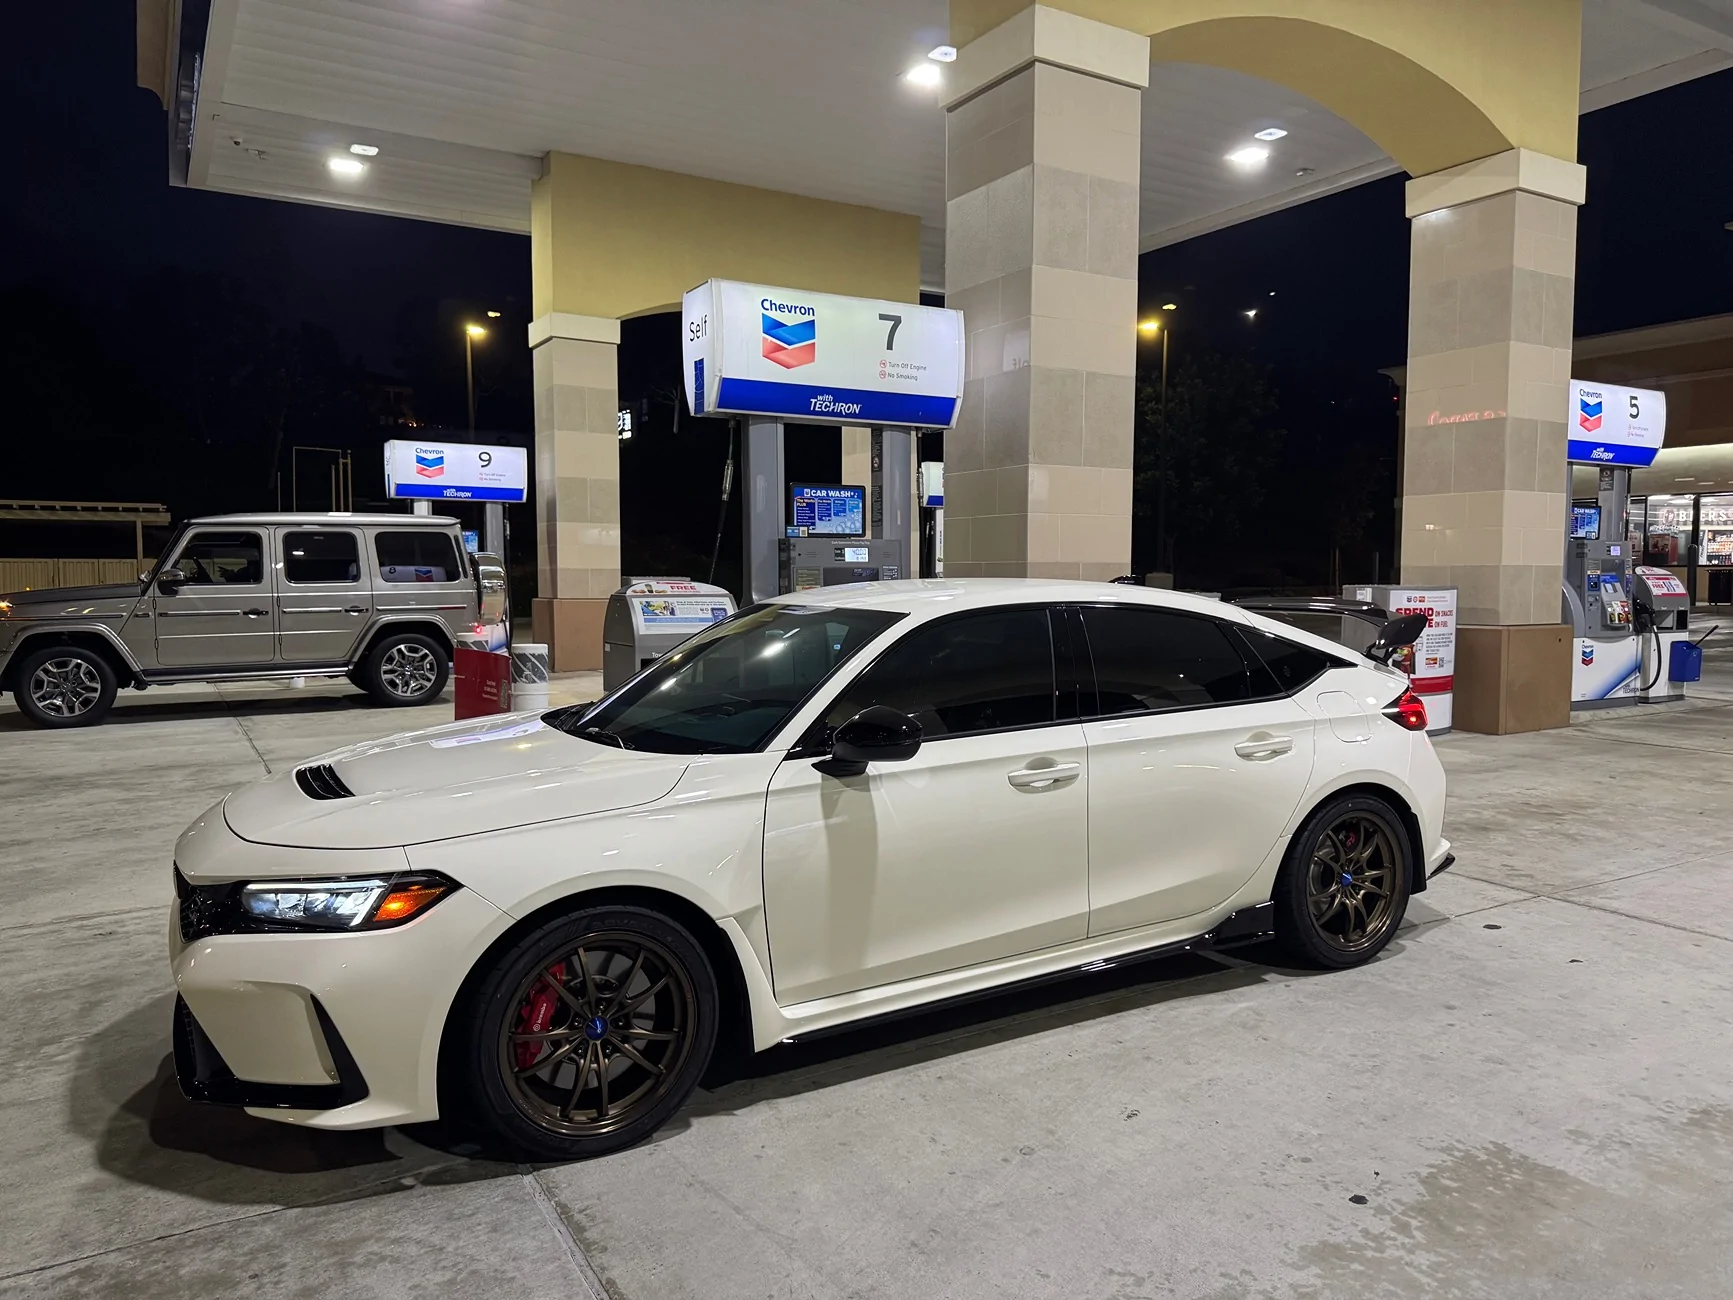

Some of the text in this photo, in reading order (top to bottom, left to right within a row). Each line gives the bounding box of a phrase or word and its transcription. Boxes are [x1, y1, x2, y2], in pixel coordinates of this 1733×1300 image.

[761, 298, 815, 317] Chevron
[689, 314, 708, 342] Self
[878, 313, 902, 351] 7
[910, 363, 927, 371] Engine
[896, 373, 918, 381] Smoking
[817, 394, 833, 402] with
[1579, 388, 1602, 399] Chevron
[810, 398, 861, 416] TECHRON
[1629, 395, 1640, 419] 5
[415, 447, 444, 455] Chevron
[478, 451, 492, 468] 9
[443, 490, 472, 498] TECHRON
[828, 490, 850, 498] WASH
